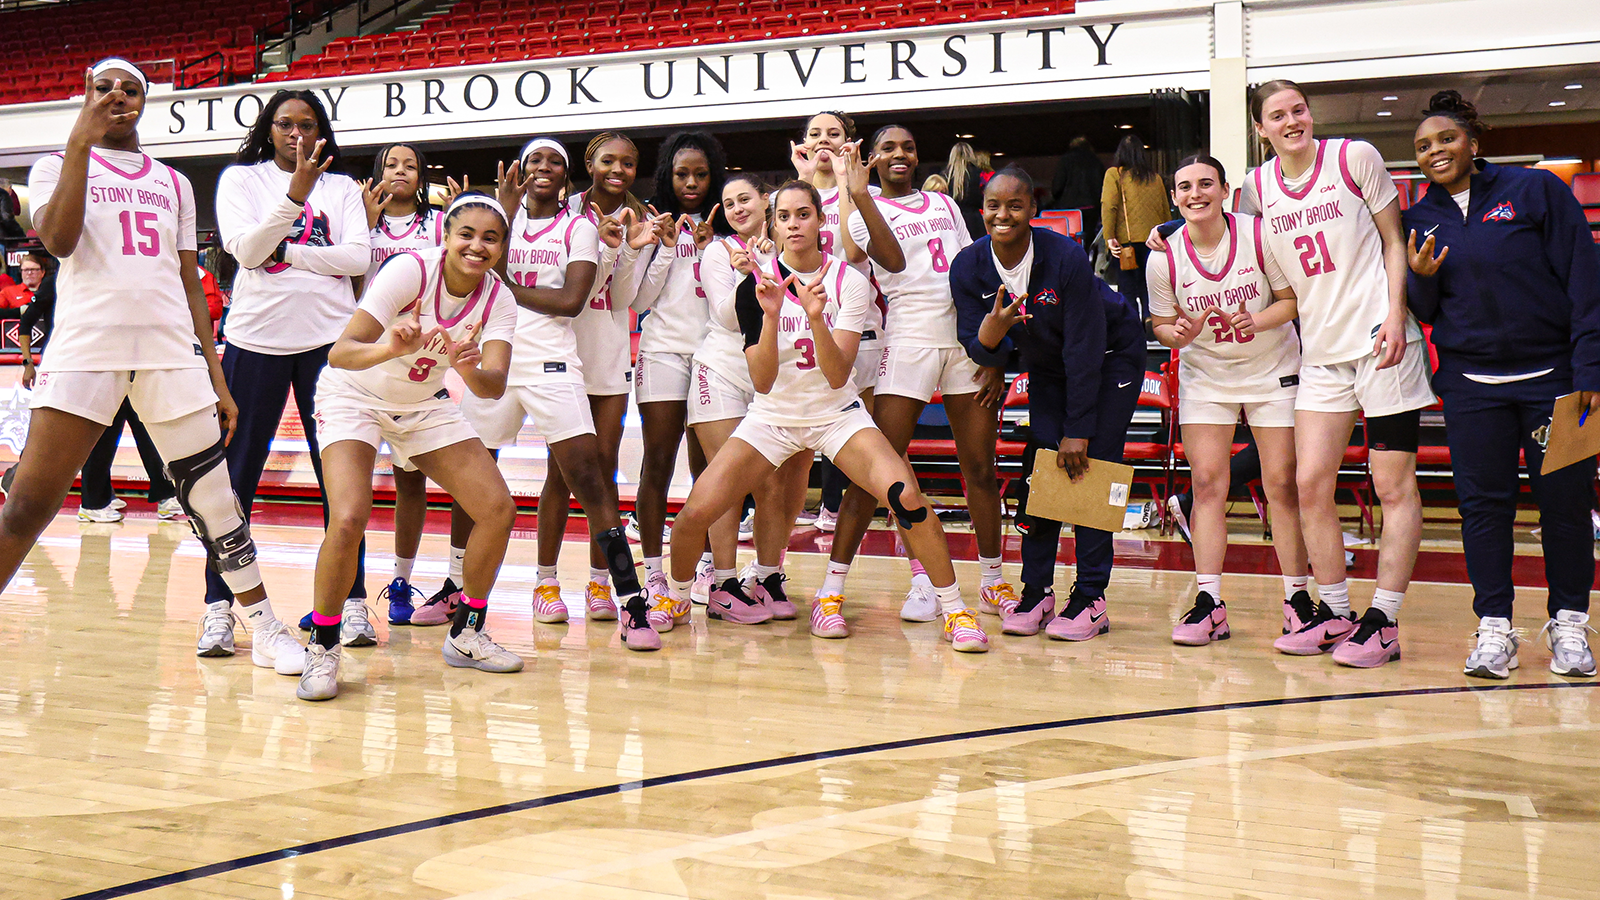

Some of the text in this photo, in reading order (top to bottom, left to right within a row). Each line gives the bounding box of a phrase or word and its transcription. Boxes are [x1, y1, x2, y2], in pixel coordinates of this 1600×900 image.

[169, 22, 1124, 134] STOY BROOK UNIVERSITY
[90, 186, 173, 213] STONY BROOK
[1320, 184, 1336, 193] CAA
[895, 221, 929, 240] STONY
[1270, 200, 1344, 234] STONY BROOK
[119, 210, 160, 257] 15
[371, 247, 396, 263] TONY
[508, 248, 560, 267] ONY BROOK
[676, 243, 698, 258] TONY
[927, 237, 950, 273] 8
[1293, 231, 1336, 277] 21
[1238, 266, 1254, 275] CAA
[1187, 281, 1260, 312] STONY BROOK
[778, 315, 804, 332] TONY
[794, 338, 816, 370] 3
[879, 345, 892, 377] WOLVES
[1141, 378, 1161, 396] OOK
